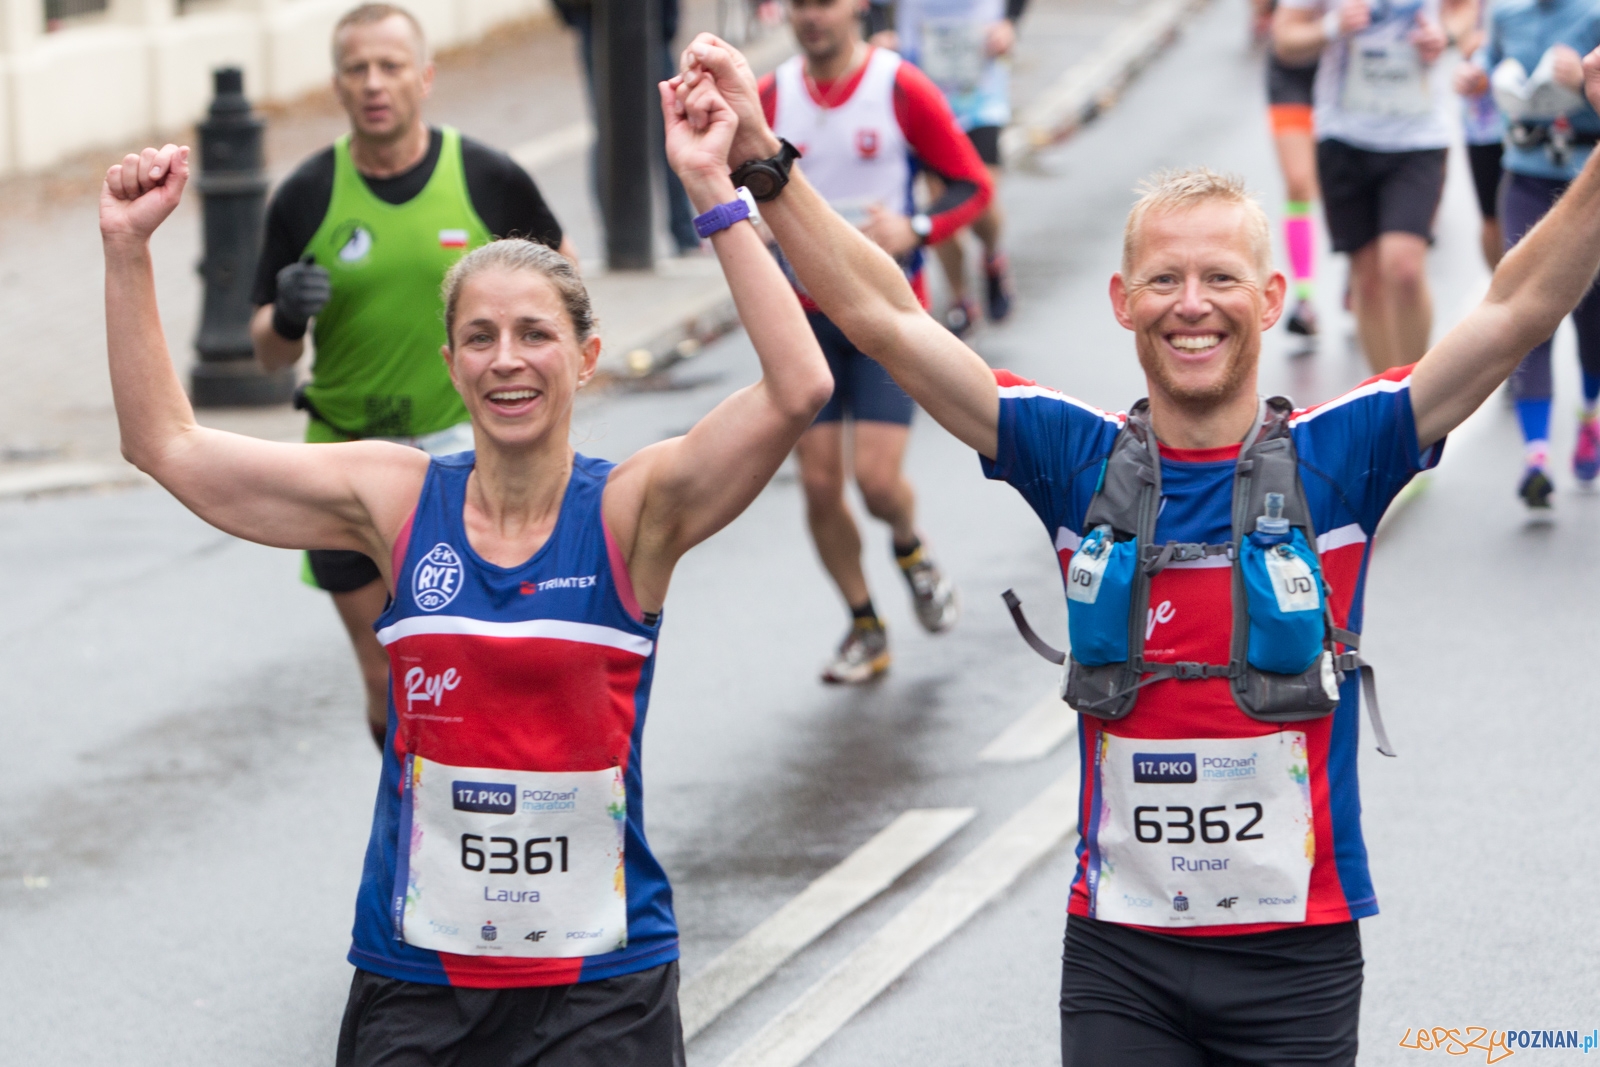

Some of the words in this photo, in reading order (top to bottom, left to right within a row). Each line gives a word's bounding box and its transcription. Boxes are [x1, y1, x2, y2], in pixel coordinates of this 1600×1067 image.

[418, 564, 458, 594] RYE
[537, 575, 597, 591] TRIMTEX
[404, 666, 462, 712] Rye
[1202, 766, 1257, 778] maraton
[522, 800, 576, 811] maraton
[1133, 801, 1265, 844] 6362
[461, 832, 569, 875] 6361
[1171, 856, 1231, 872] Runar
[484, 886, 541, 903] Laura
[1216, 896, 1239, 909] 4F
[524, 930, 548, 943] 4F
